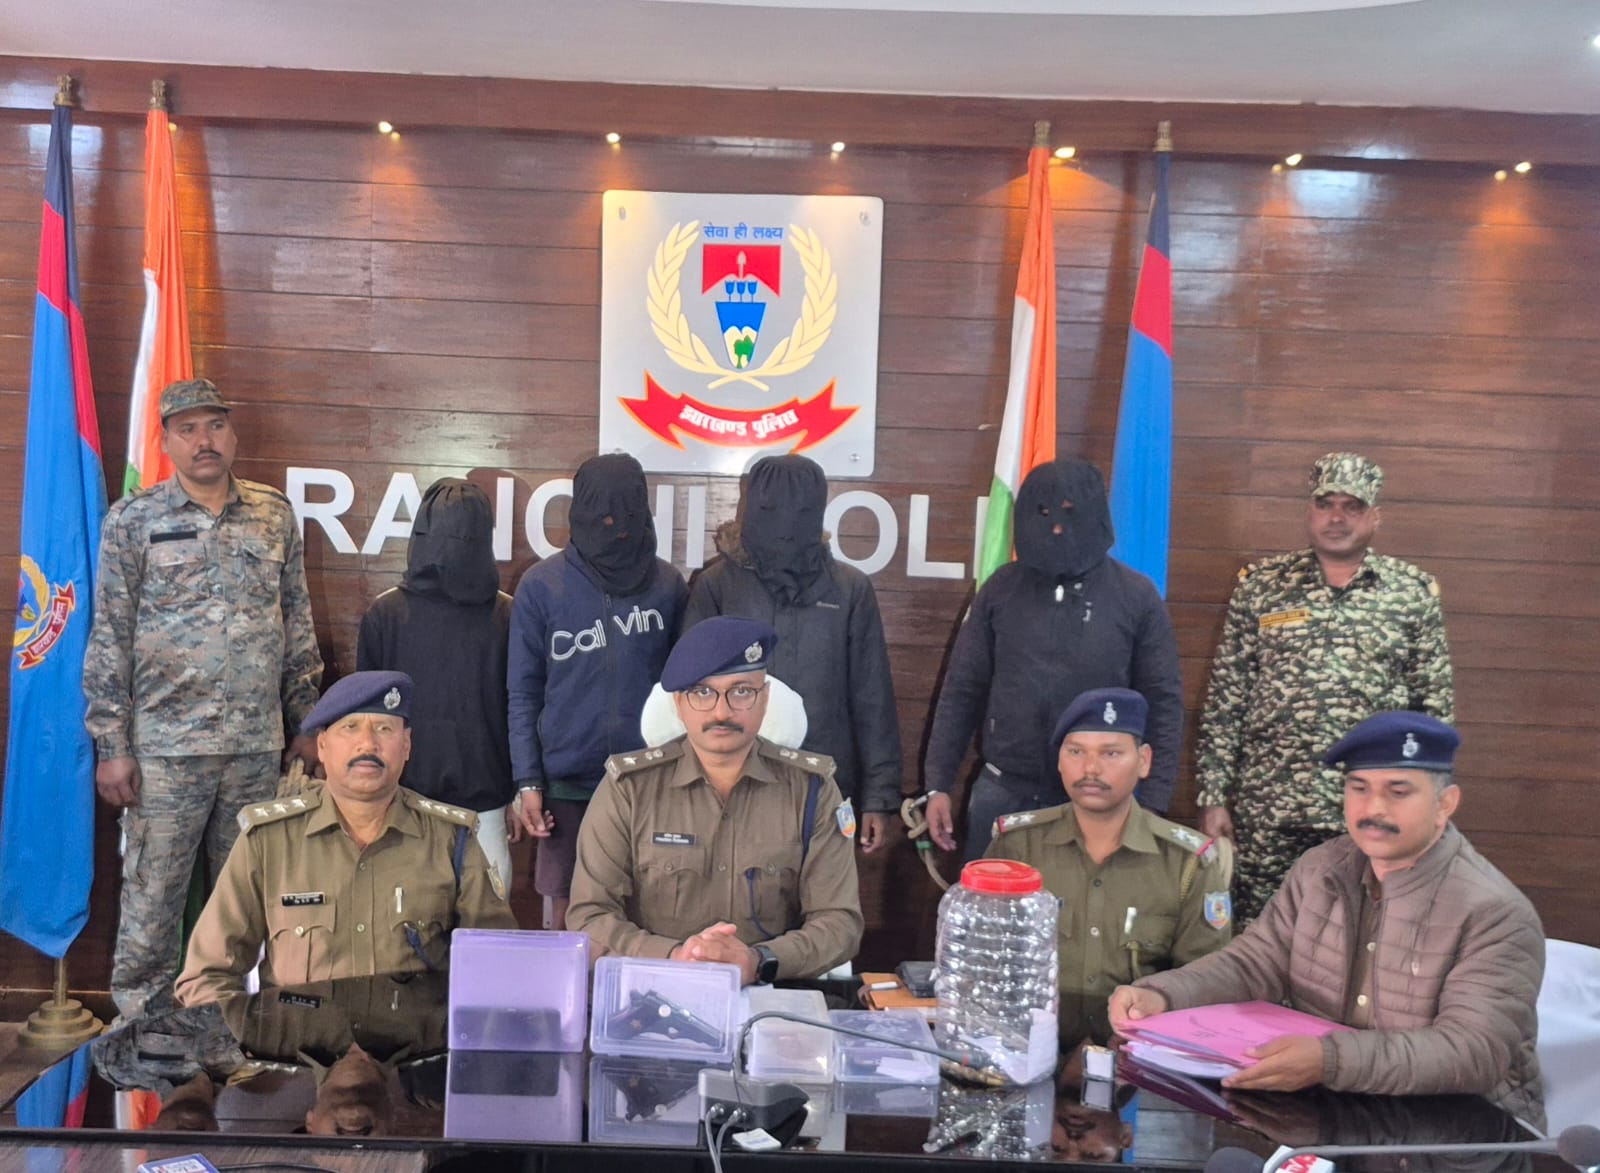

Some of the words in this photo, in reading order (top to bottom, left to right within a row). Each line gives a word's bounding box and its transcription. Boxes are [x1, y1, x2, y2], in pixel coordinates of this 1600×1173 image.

[703, 221, 728, 238] सेवा
[734, 222, 748, 239] ही
[753, 227, 784, 239] लक्ष्य
[751, 409, 799, 438] पुलिस
